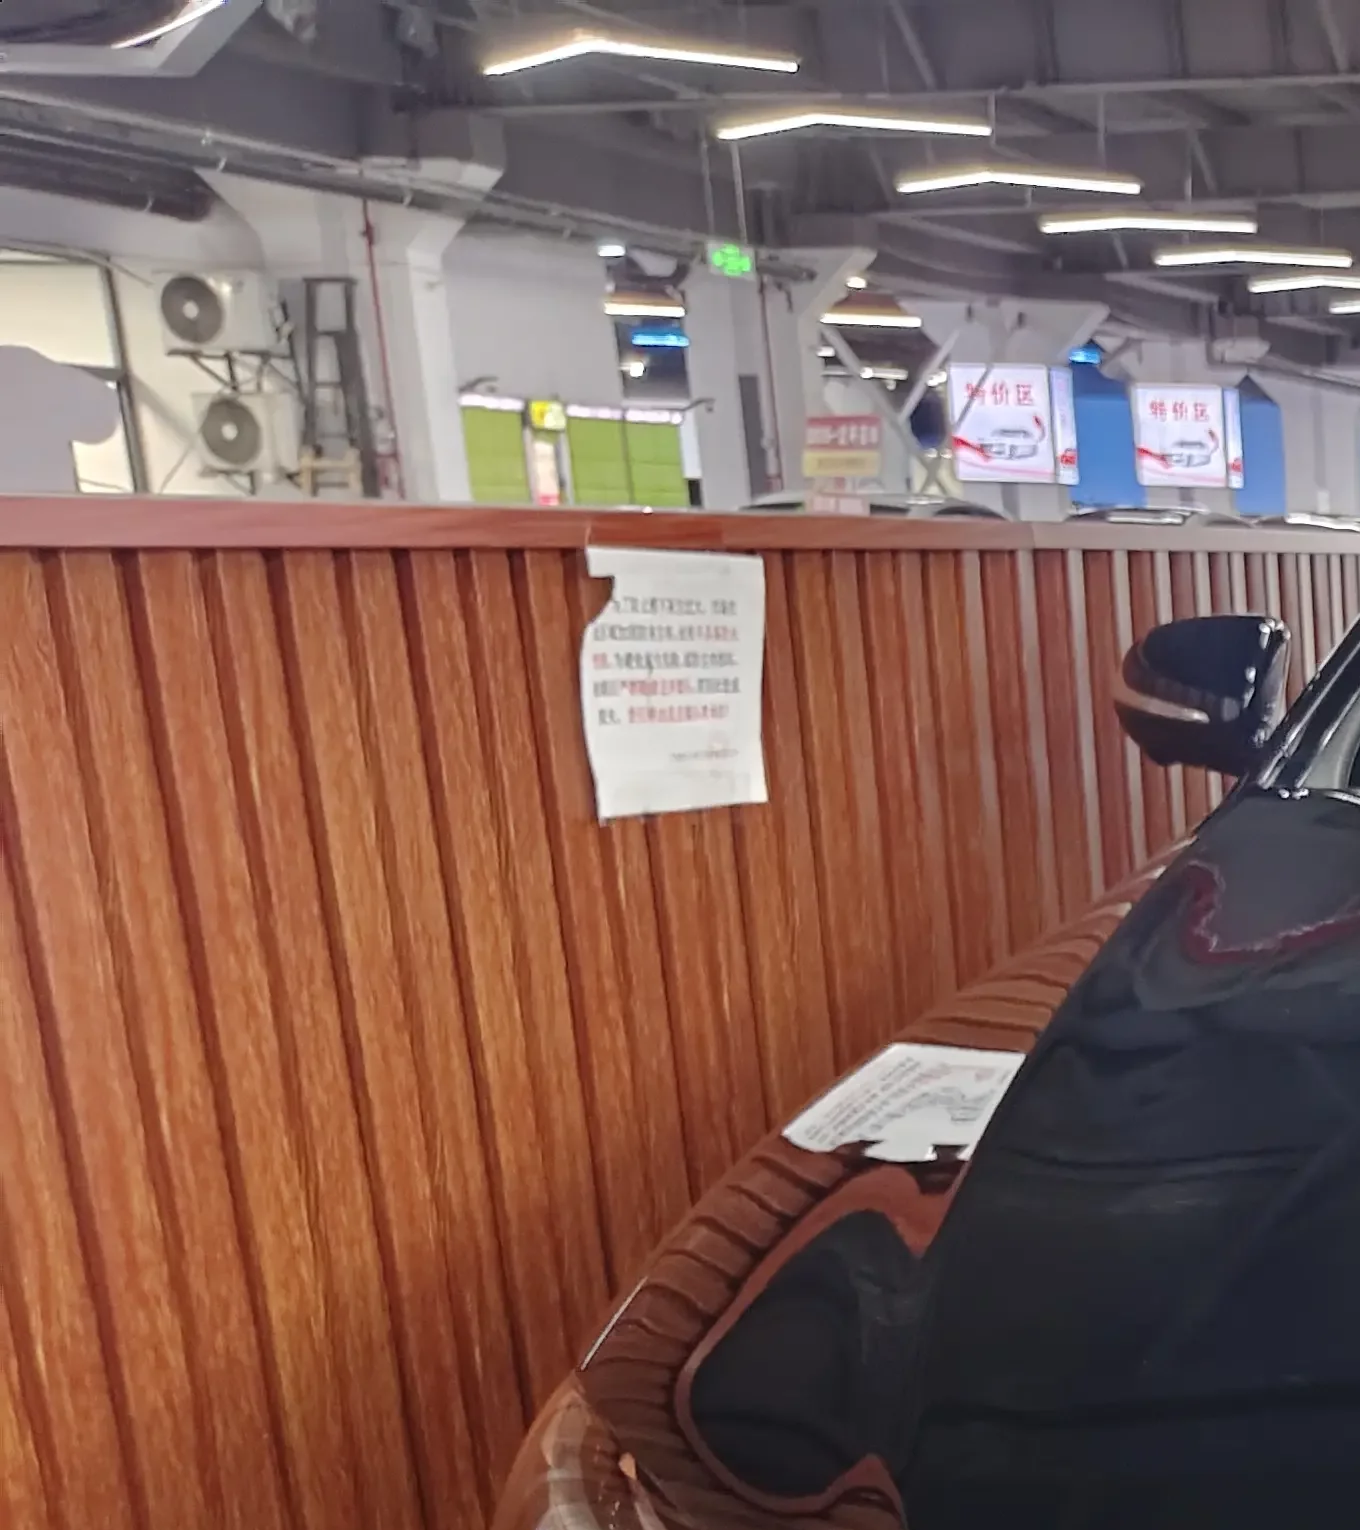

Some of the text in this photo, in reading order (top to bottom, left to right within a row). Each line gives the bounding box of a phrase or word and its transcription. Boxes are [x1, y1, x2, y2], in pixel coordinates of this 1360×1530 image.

[965, 381, 1035, 407] 特价区
[1149, 399, 1210, 423] 特价区
